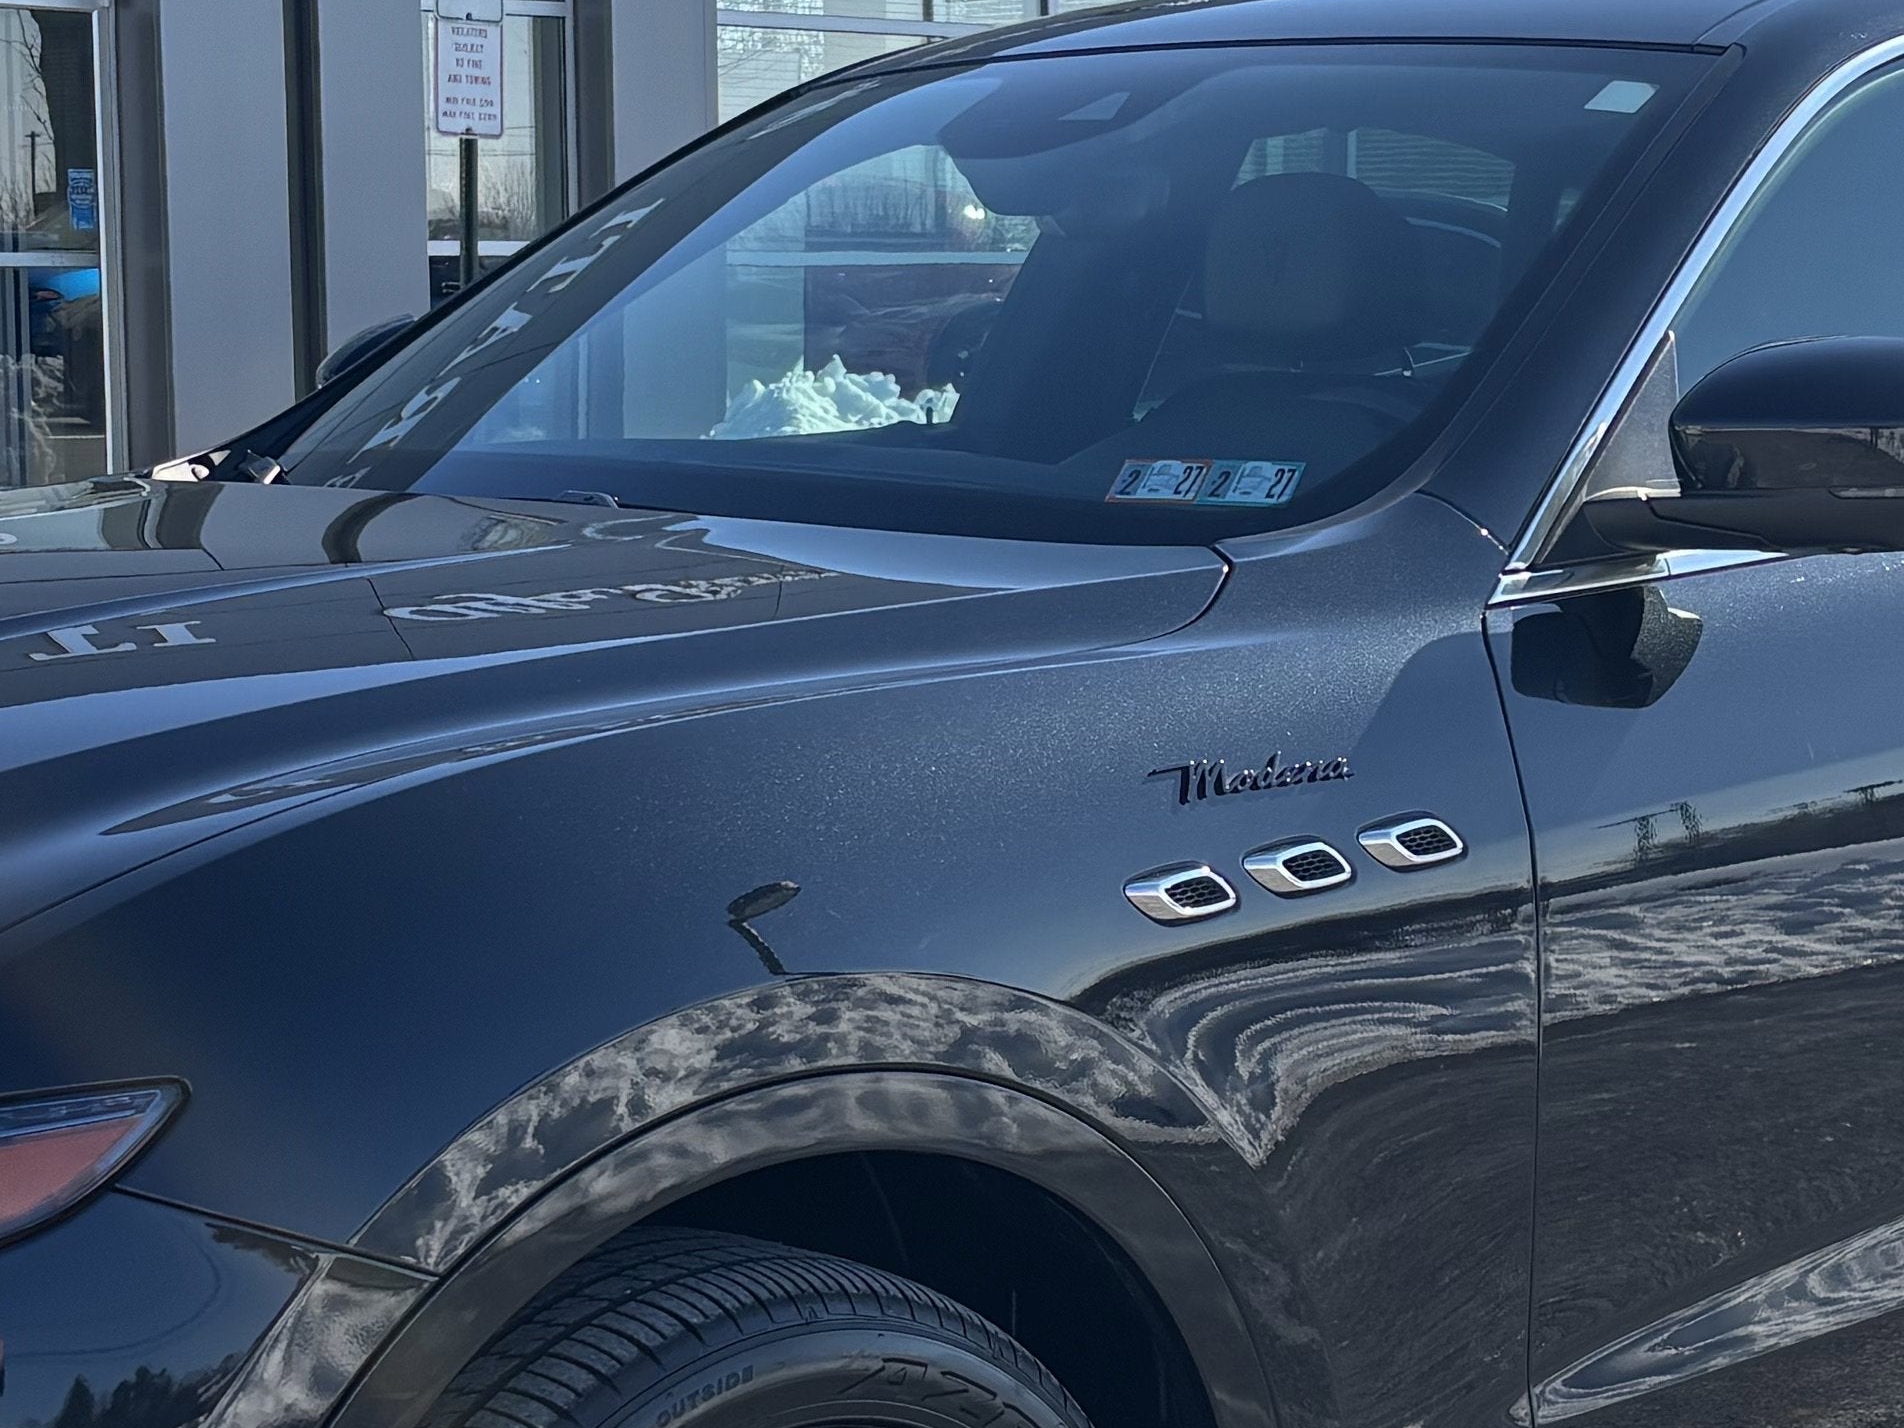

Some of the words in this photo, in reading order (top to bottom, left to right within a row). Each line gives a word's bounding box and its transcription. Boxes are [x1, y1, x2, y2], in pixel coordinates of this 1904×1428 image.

[1116, 469, 1142, 495] 2
[1173, 465, 1207, 498] 27
[1208, 470, 1232, 498] 2
[1264, 468, 1297, 502] 27
[1146, 750, 1356, 806] Modena
